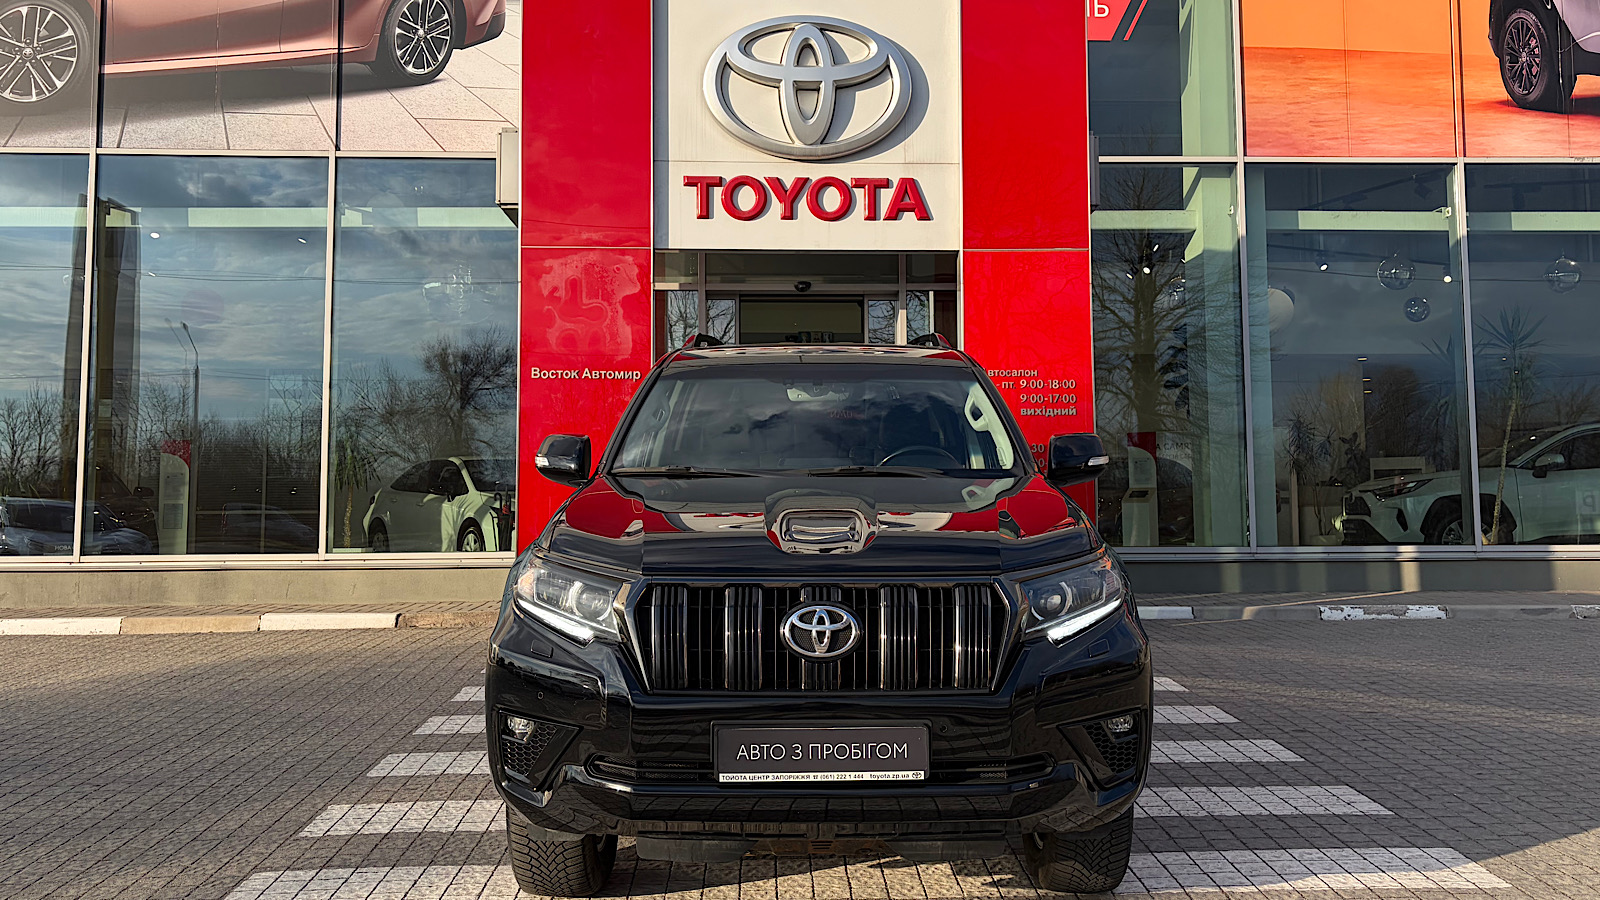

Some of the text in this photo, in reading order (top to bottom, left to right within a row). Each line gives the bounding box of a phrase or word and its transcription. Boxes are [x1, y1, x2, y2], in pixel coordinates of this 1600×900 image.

[683, 175, 932, 221] TOYOTA
[531, 367, 641, 382] Восток Автомир
[986, 369, 1038, 377] втосалон
[1021, 406, 1077, 417] вихідний
[736, 744, 786, 760] АВТО
[808, 743, 908, 759] ПРОБІГОМ
